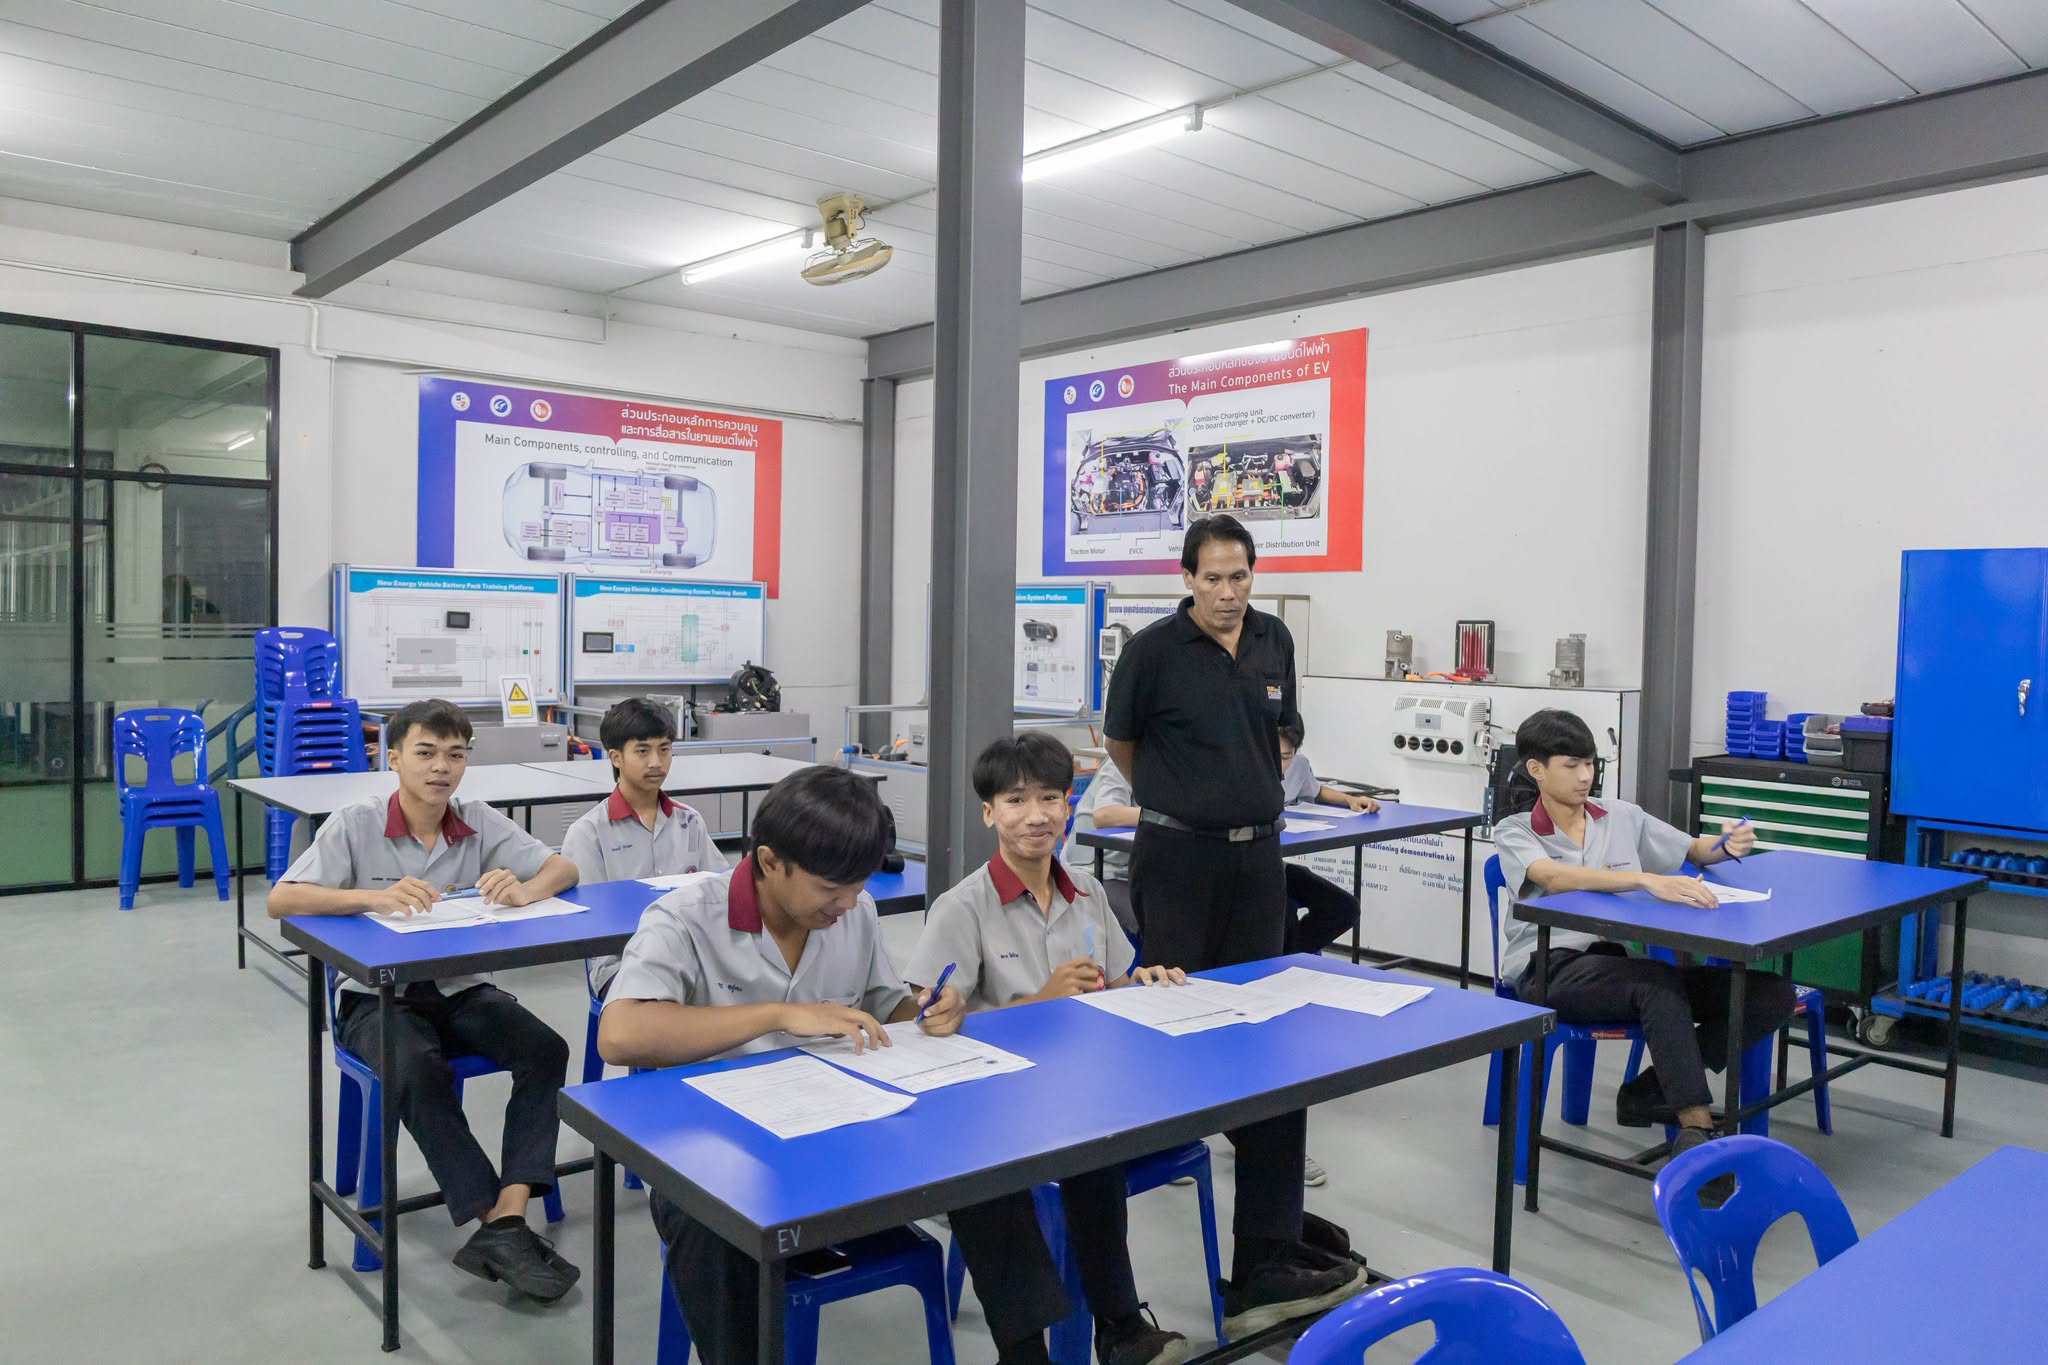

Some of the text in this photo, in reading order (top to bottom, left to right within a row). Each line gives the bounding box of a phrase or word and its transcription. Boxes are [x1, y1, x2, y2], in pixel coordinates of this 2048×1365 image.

[1168, 361, 1330, 395] The Main Components of EV
[621, 404, 758, 435] ส่วนประกอบหลักการควบคุม
[1193, 408, 1264, 424] Combine Charging Unit
[1206, 421, 1223, 430] board
[1224, 419, 1248, 428] charger
[1257, 415, 1279, 424] DC/DC
[1280, 410, 1316, 421] converter)
[621, 424, 758, 448] และการสื่อสารในยานยนต์ไฟฟ้า
[485, 433, 511, 446] Main
[514, 436, 582, 454] Components,
[585, 445, 639, 461] controlling,
[642, 450, 659, 461] and
[662, 451, 733, 467] Communication
[1265, 540, 1304, 549] Distribution
[1305, 540, 1320, 548] Unit
[393, 580, 416, 588] Energy
[418, 580, 441, 588] Vehicle
[442, 581, 465, 590] Battery
[466, 582, 481, 590] Pack
[482, 583, 507, 591] Training
[1027, 594, 1045, 602] System
[1046, 593, 1067, 601] Platform
[1400, 847, 1445, 860] demonstration
[1446, 853, 1455, 862] kit
[380, 967, 396, 985] EV
[1542, 1014, 1554, 1035] EV
[778, 1225, 801, 1254] EV
